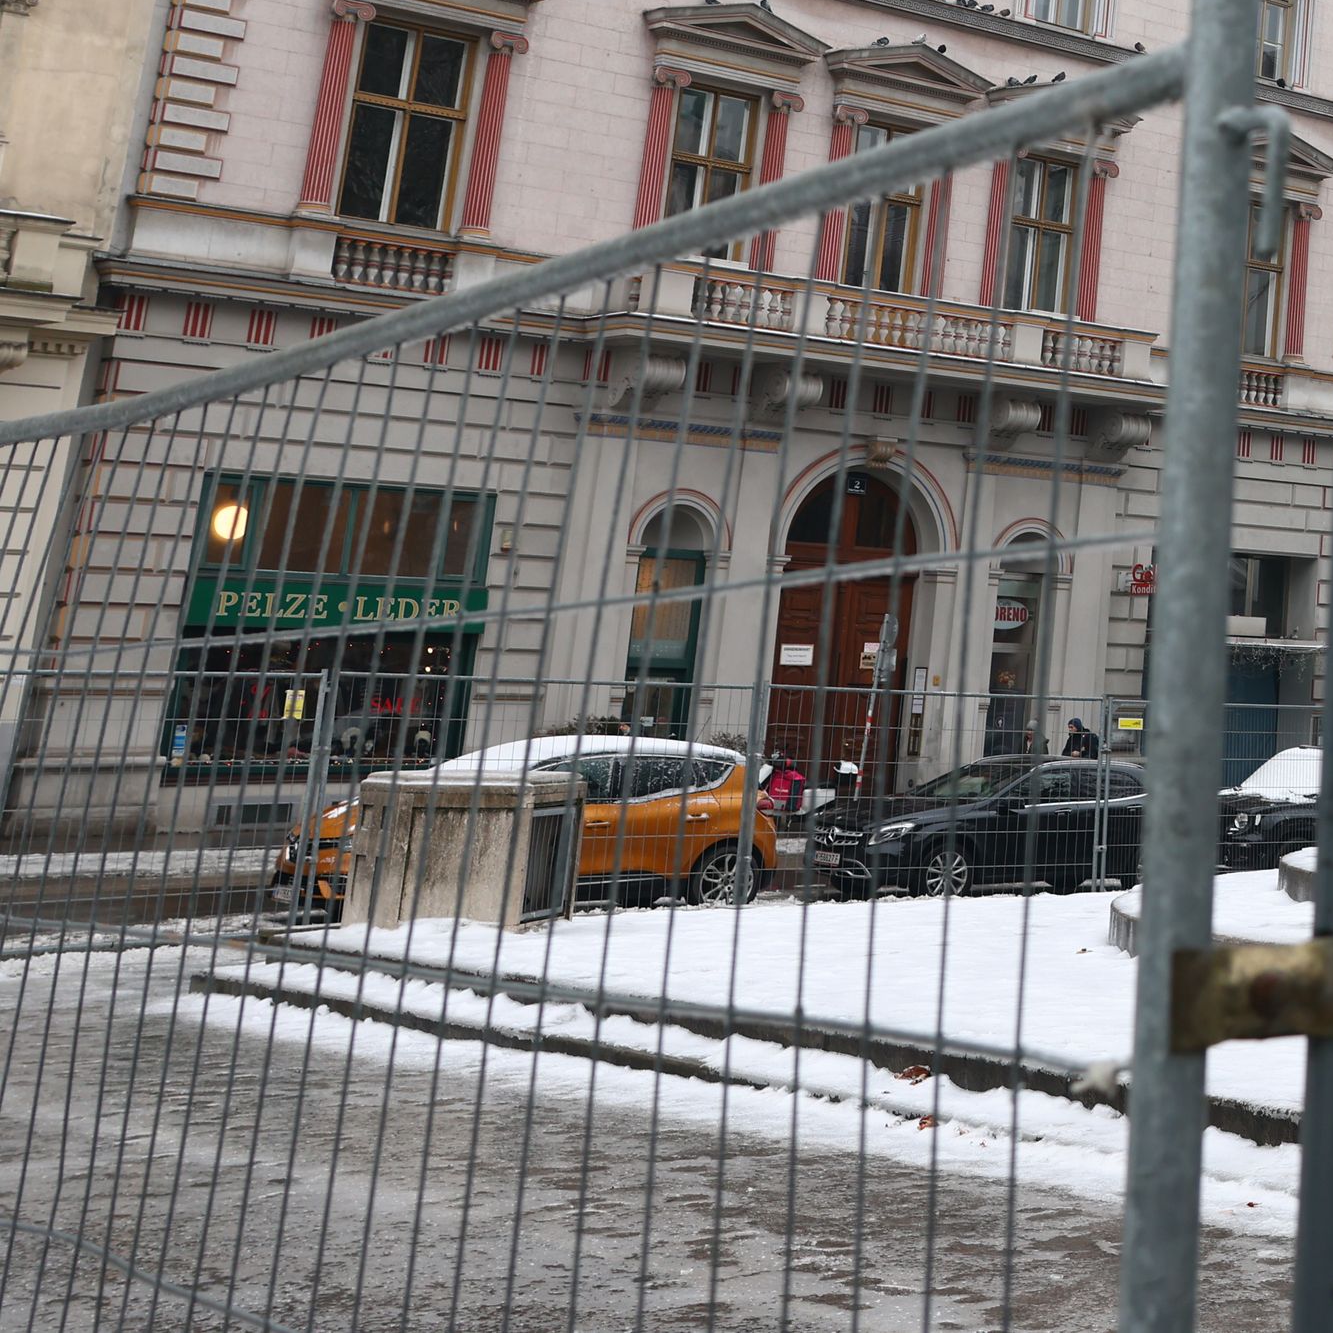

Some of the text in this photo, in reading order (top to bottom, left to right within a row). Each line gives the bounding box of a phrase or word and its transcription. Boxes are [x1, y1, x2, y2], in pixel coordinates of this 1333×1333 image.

[854, 480, 861, 489] 2
[215, 591, 461, 622] PELZE LEDER
